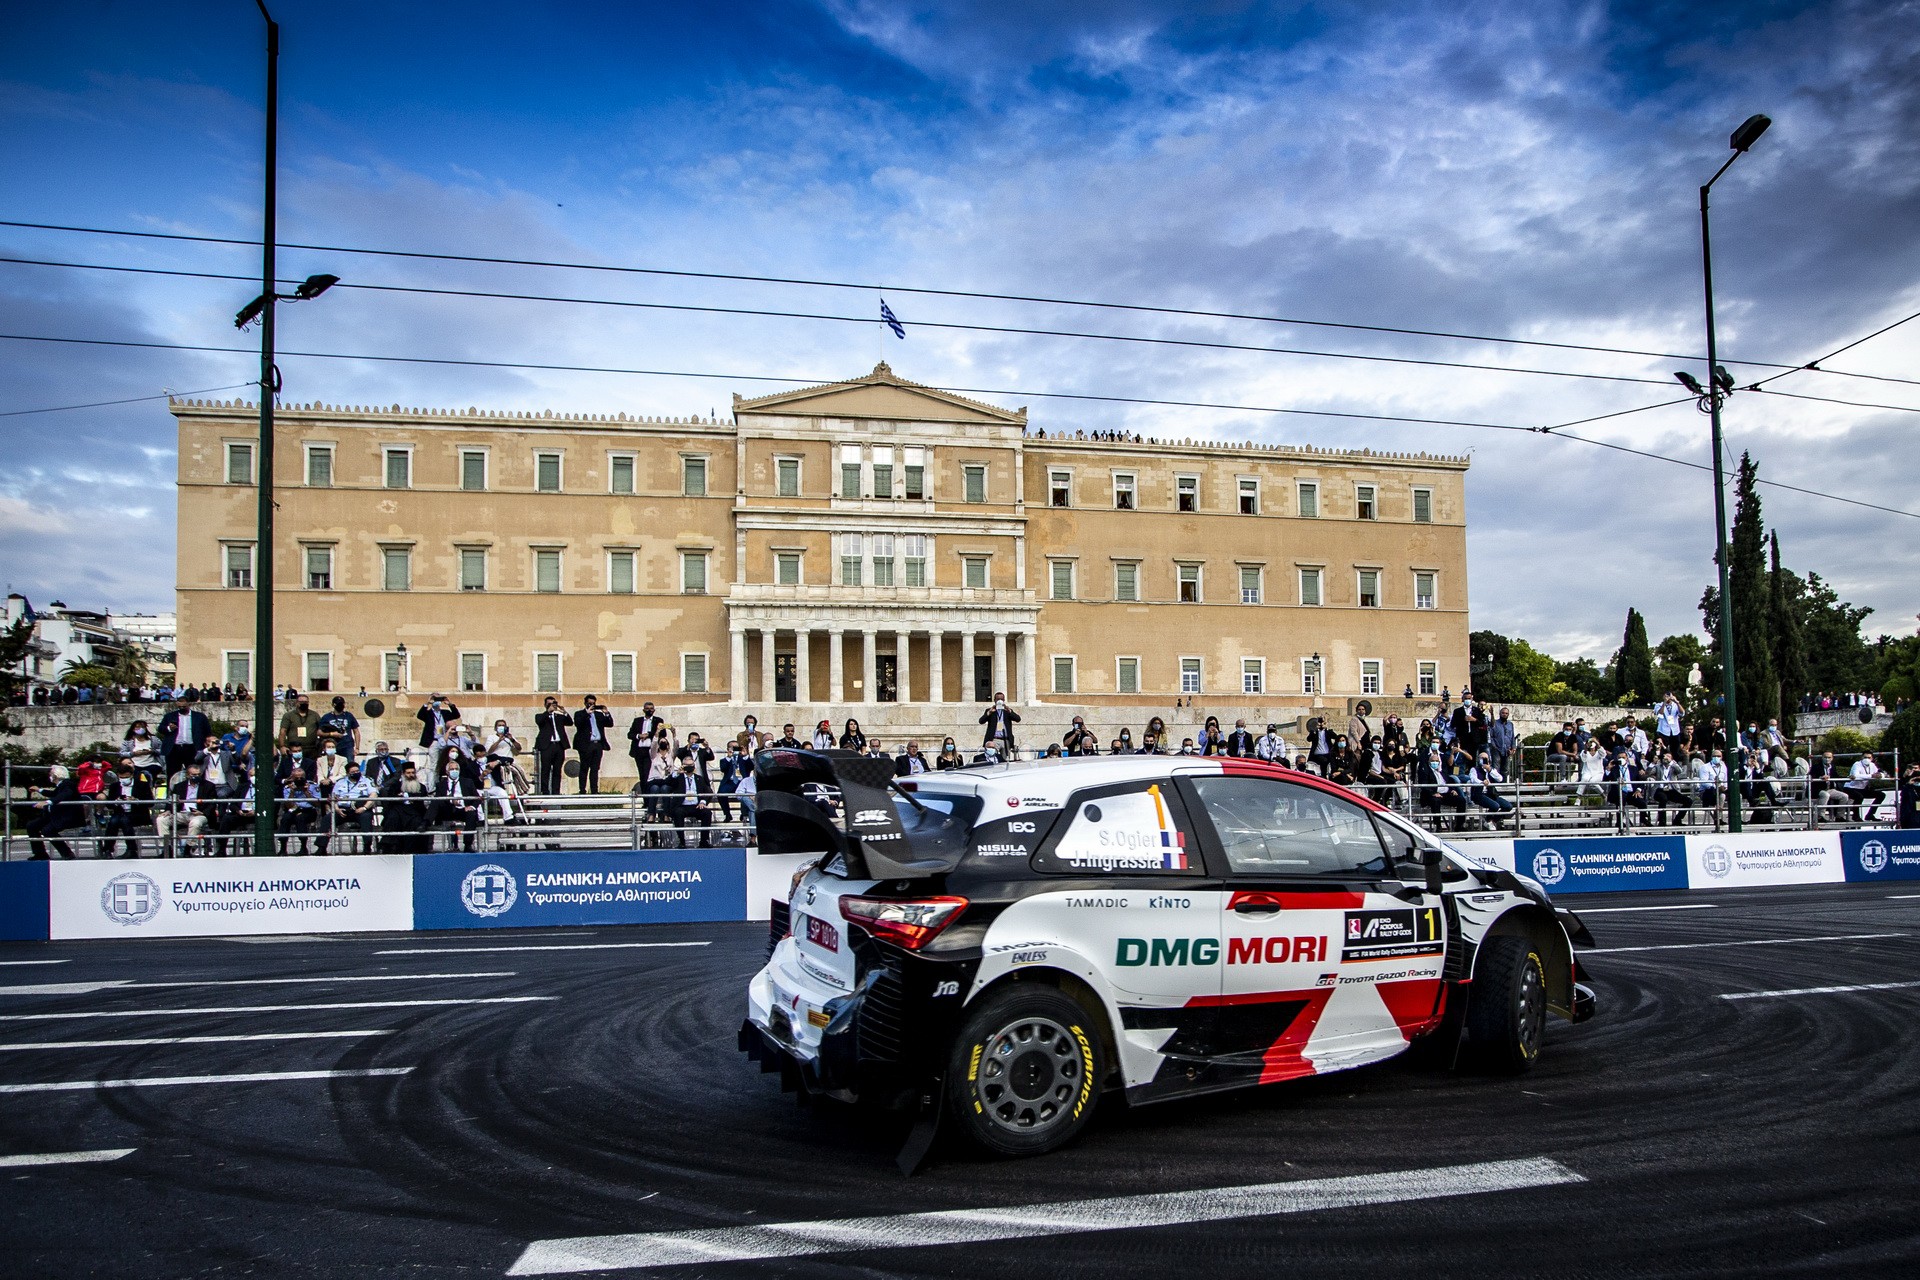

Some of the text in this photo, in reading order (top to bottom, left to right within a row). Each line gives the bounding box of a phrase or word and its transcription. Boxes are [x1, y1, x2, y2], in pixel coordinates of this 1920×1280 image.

[1147, 784, 1166, 829] 1
[861, 833, 902, 841] PONSSE
[1099, 831, 1157, 850] S.Ogier
[977, 844, 1027, 852] NISULA
[1735, 847, 1826, 859] ΕΛΛΗΝΙΚΗ ΔΗΜΟΚΡΑΤΙΑ
[1070, 851, 1162, 871] J.Ingrassia
[1570, 851, 1670, 864] ΕΛΛΗΝΙΚΗ ΔΗΜΟΚΡΑΤΙΑ
[1736, 858, 1822, 871] Υφυπουργείο Αθλητισμού
[1571, 863, 1665, 877] Υφυπουργείο Αθλητισμού
[172, 878, 361, 893] ΕΛΛΗΝΙΚΗ ΔΗΜΟΚΡΑΤΙΑ
[526, 870, 702, 887] ΕΛΛΗΝΙΚΗ ΔΗΜΟΚΡΑΤΙΑ
[526, 887, 691, 906] Υφυπουργείο Αθλητισμού
[1065, 898, 1129, 908] TAMADIC
[172, 896, 350, 914] Υφυπουργείο Αθλητισμού
[1424, 908, 1435, 940] 1
[1012, 951, 1048, 964] ENDLESS
[1115, 936, 1328, 966] DMG MORI
[1338, 975, 1375, 984] TOYOTA
[1376, 971, 1406, 980] GAZOO
[1407, 969, 1437, 977] Racing
